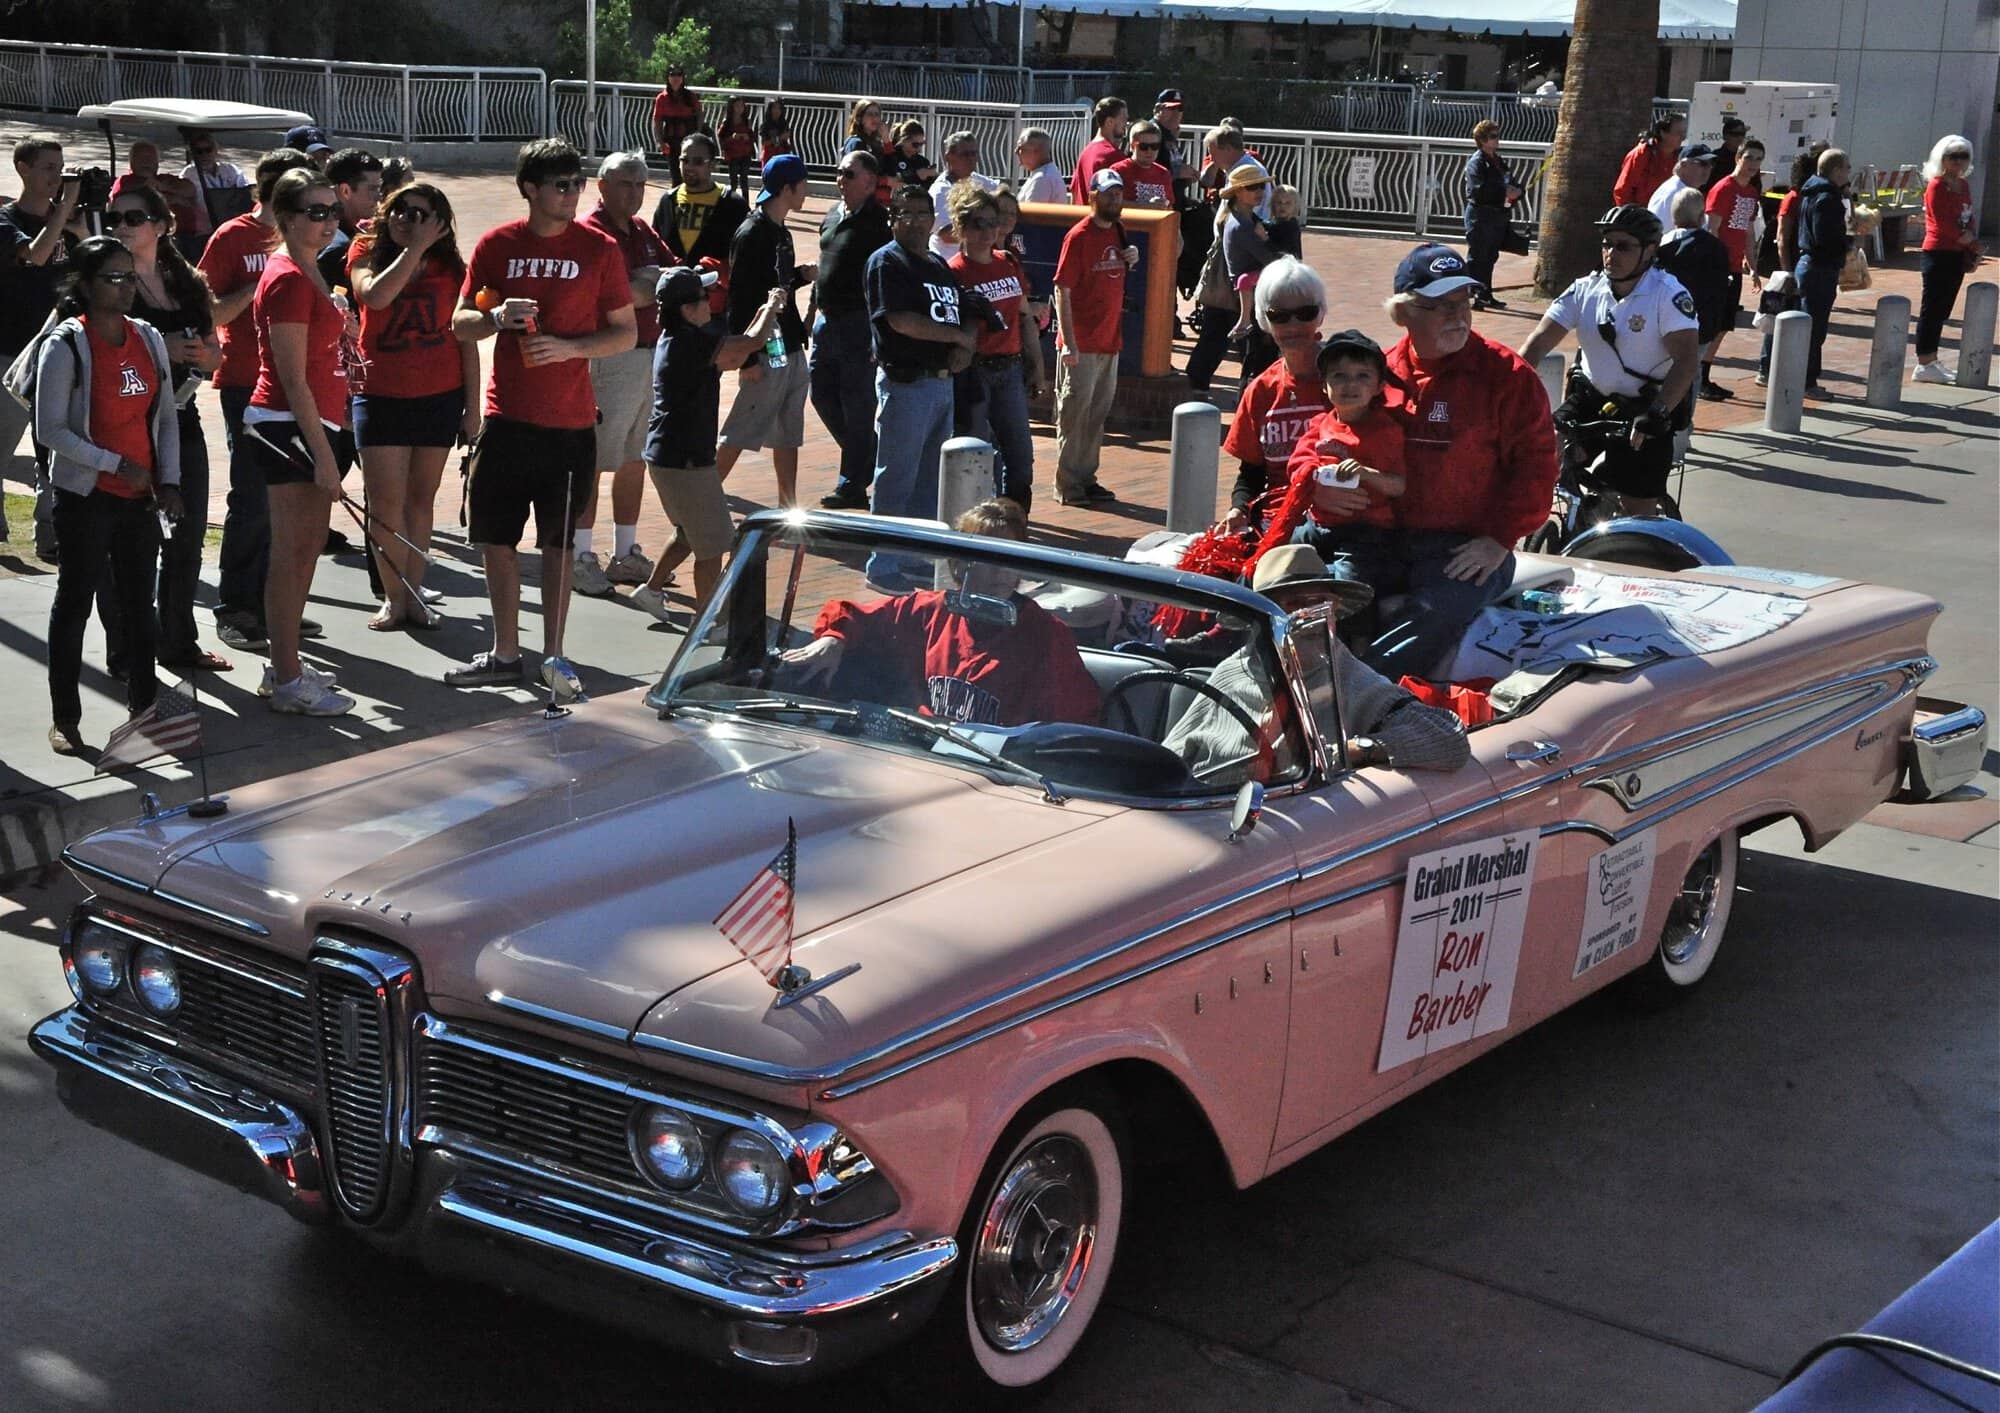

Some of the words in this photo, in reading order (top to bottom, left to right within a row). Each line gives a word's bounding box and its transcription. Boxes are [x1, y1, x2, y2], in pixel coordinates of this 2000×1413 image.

[506, 258, 580, 280] BTFD
[119, 366, 148, 397] A
[1428, 401, 1449, 422] A
[1414, 857, 1465, 902] Grand
[1464, 841, 1531, 889] Marshal
[1450, 891, 1484, 926] 2011
[1436, 931, 1485, 978] Ron
[1406, 980, 1492, 1040] Barber
